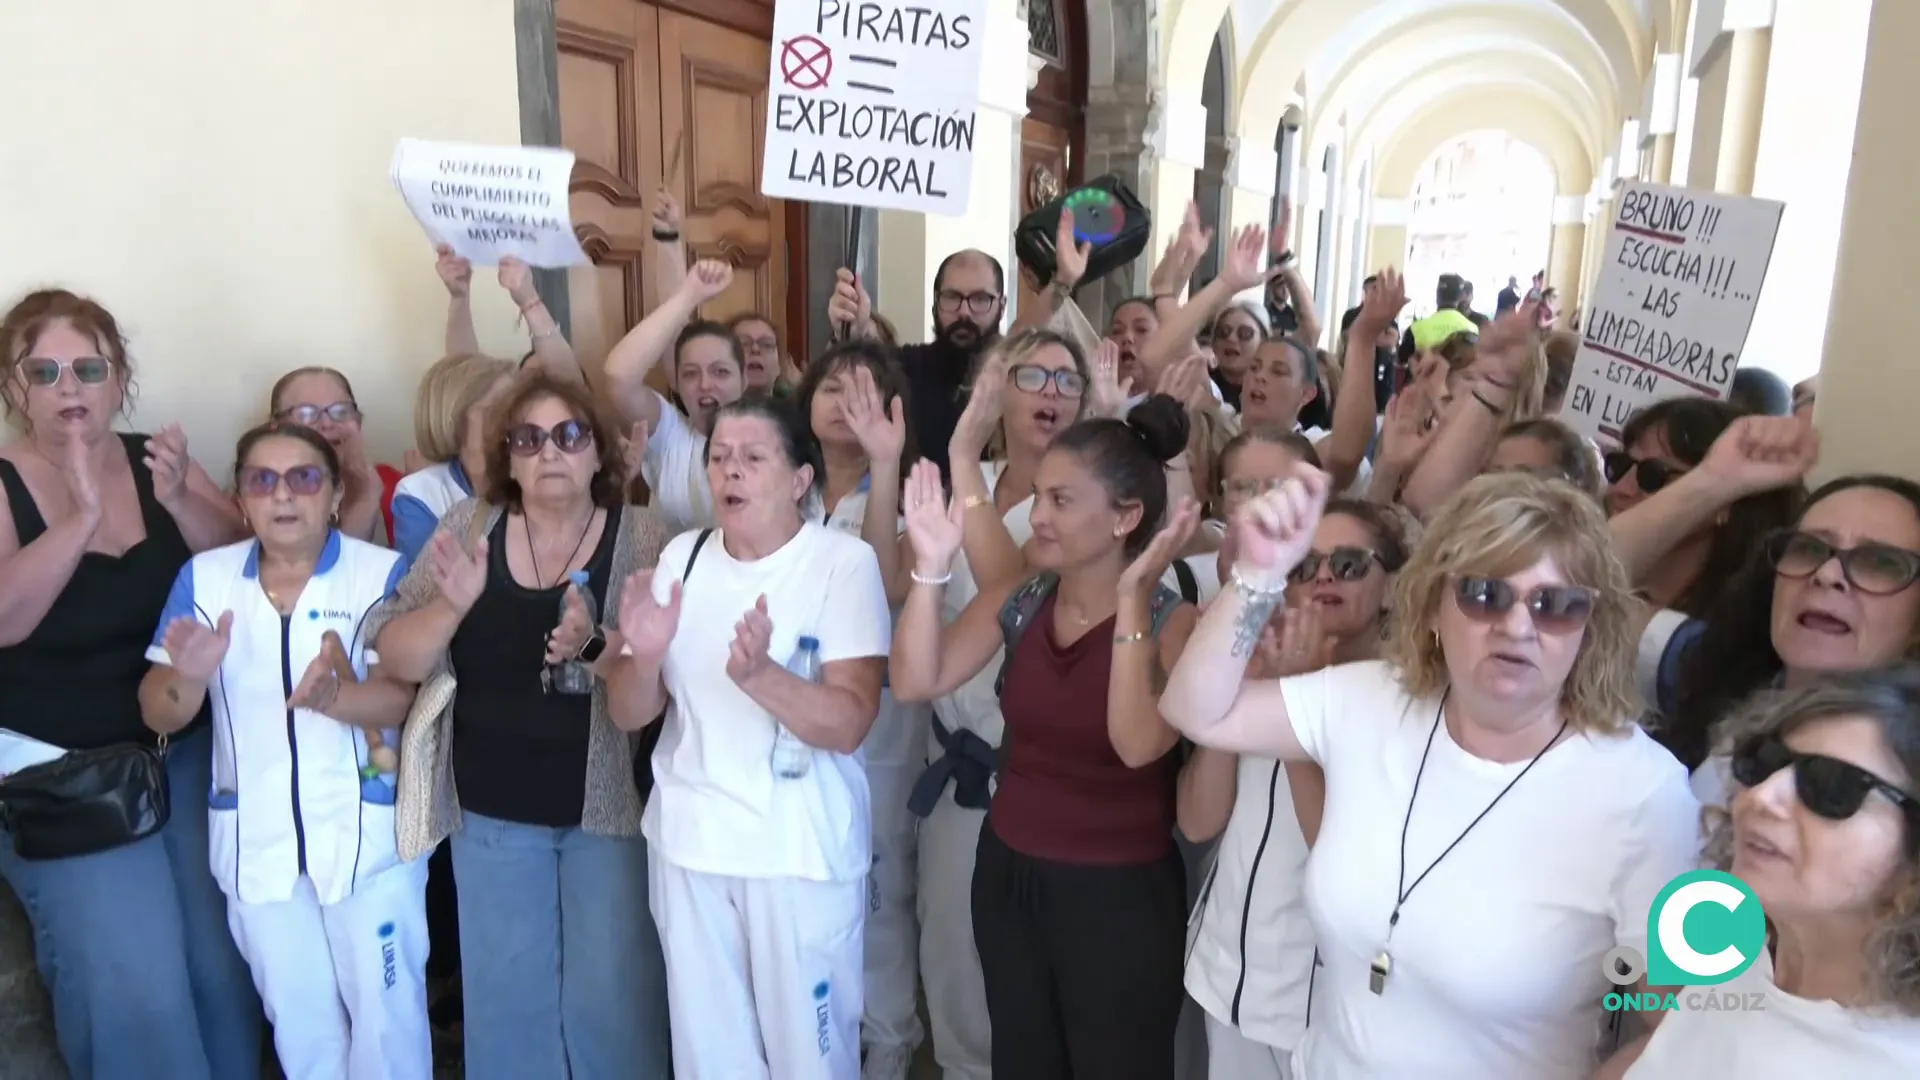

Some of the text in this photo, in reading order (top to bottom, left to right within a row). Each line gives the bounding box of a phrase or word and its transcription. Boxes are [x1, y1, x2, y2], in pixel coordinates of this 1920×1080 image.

[817, 0, 971, 49] PIRATAS
[776, 94, 975, 152] EXPLOTACIÓN
[788, 148, 947, 198] LABORAL
[431, 181, 551, 208] CUMPLIMIENTO
[432, 202, 457, 219] DEL
[1620, 190, 1694, 232] BRUNO
[1641, 284, 1681, 318] LAS
[1586, 307, 1735, 386] LIMPIADORAS
[1571, 384, 1632, 425] EN LU
